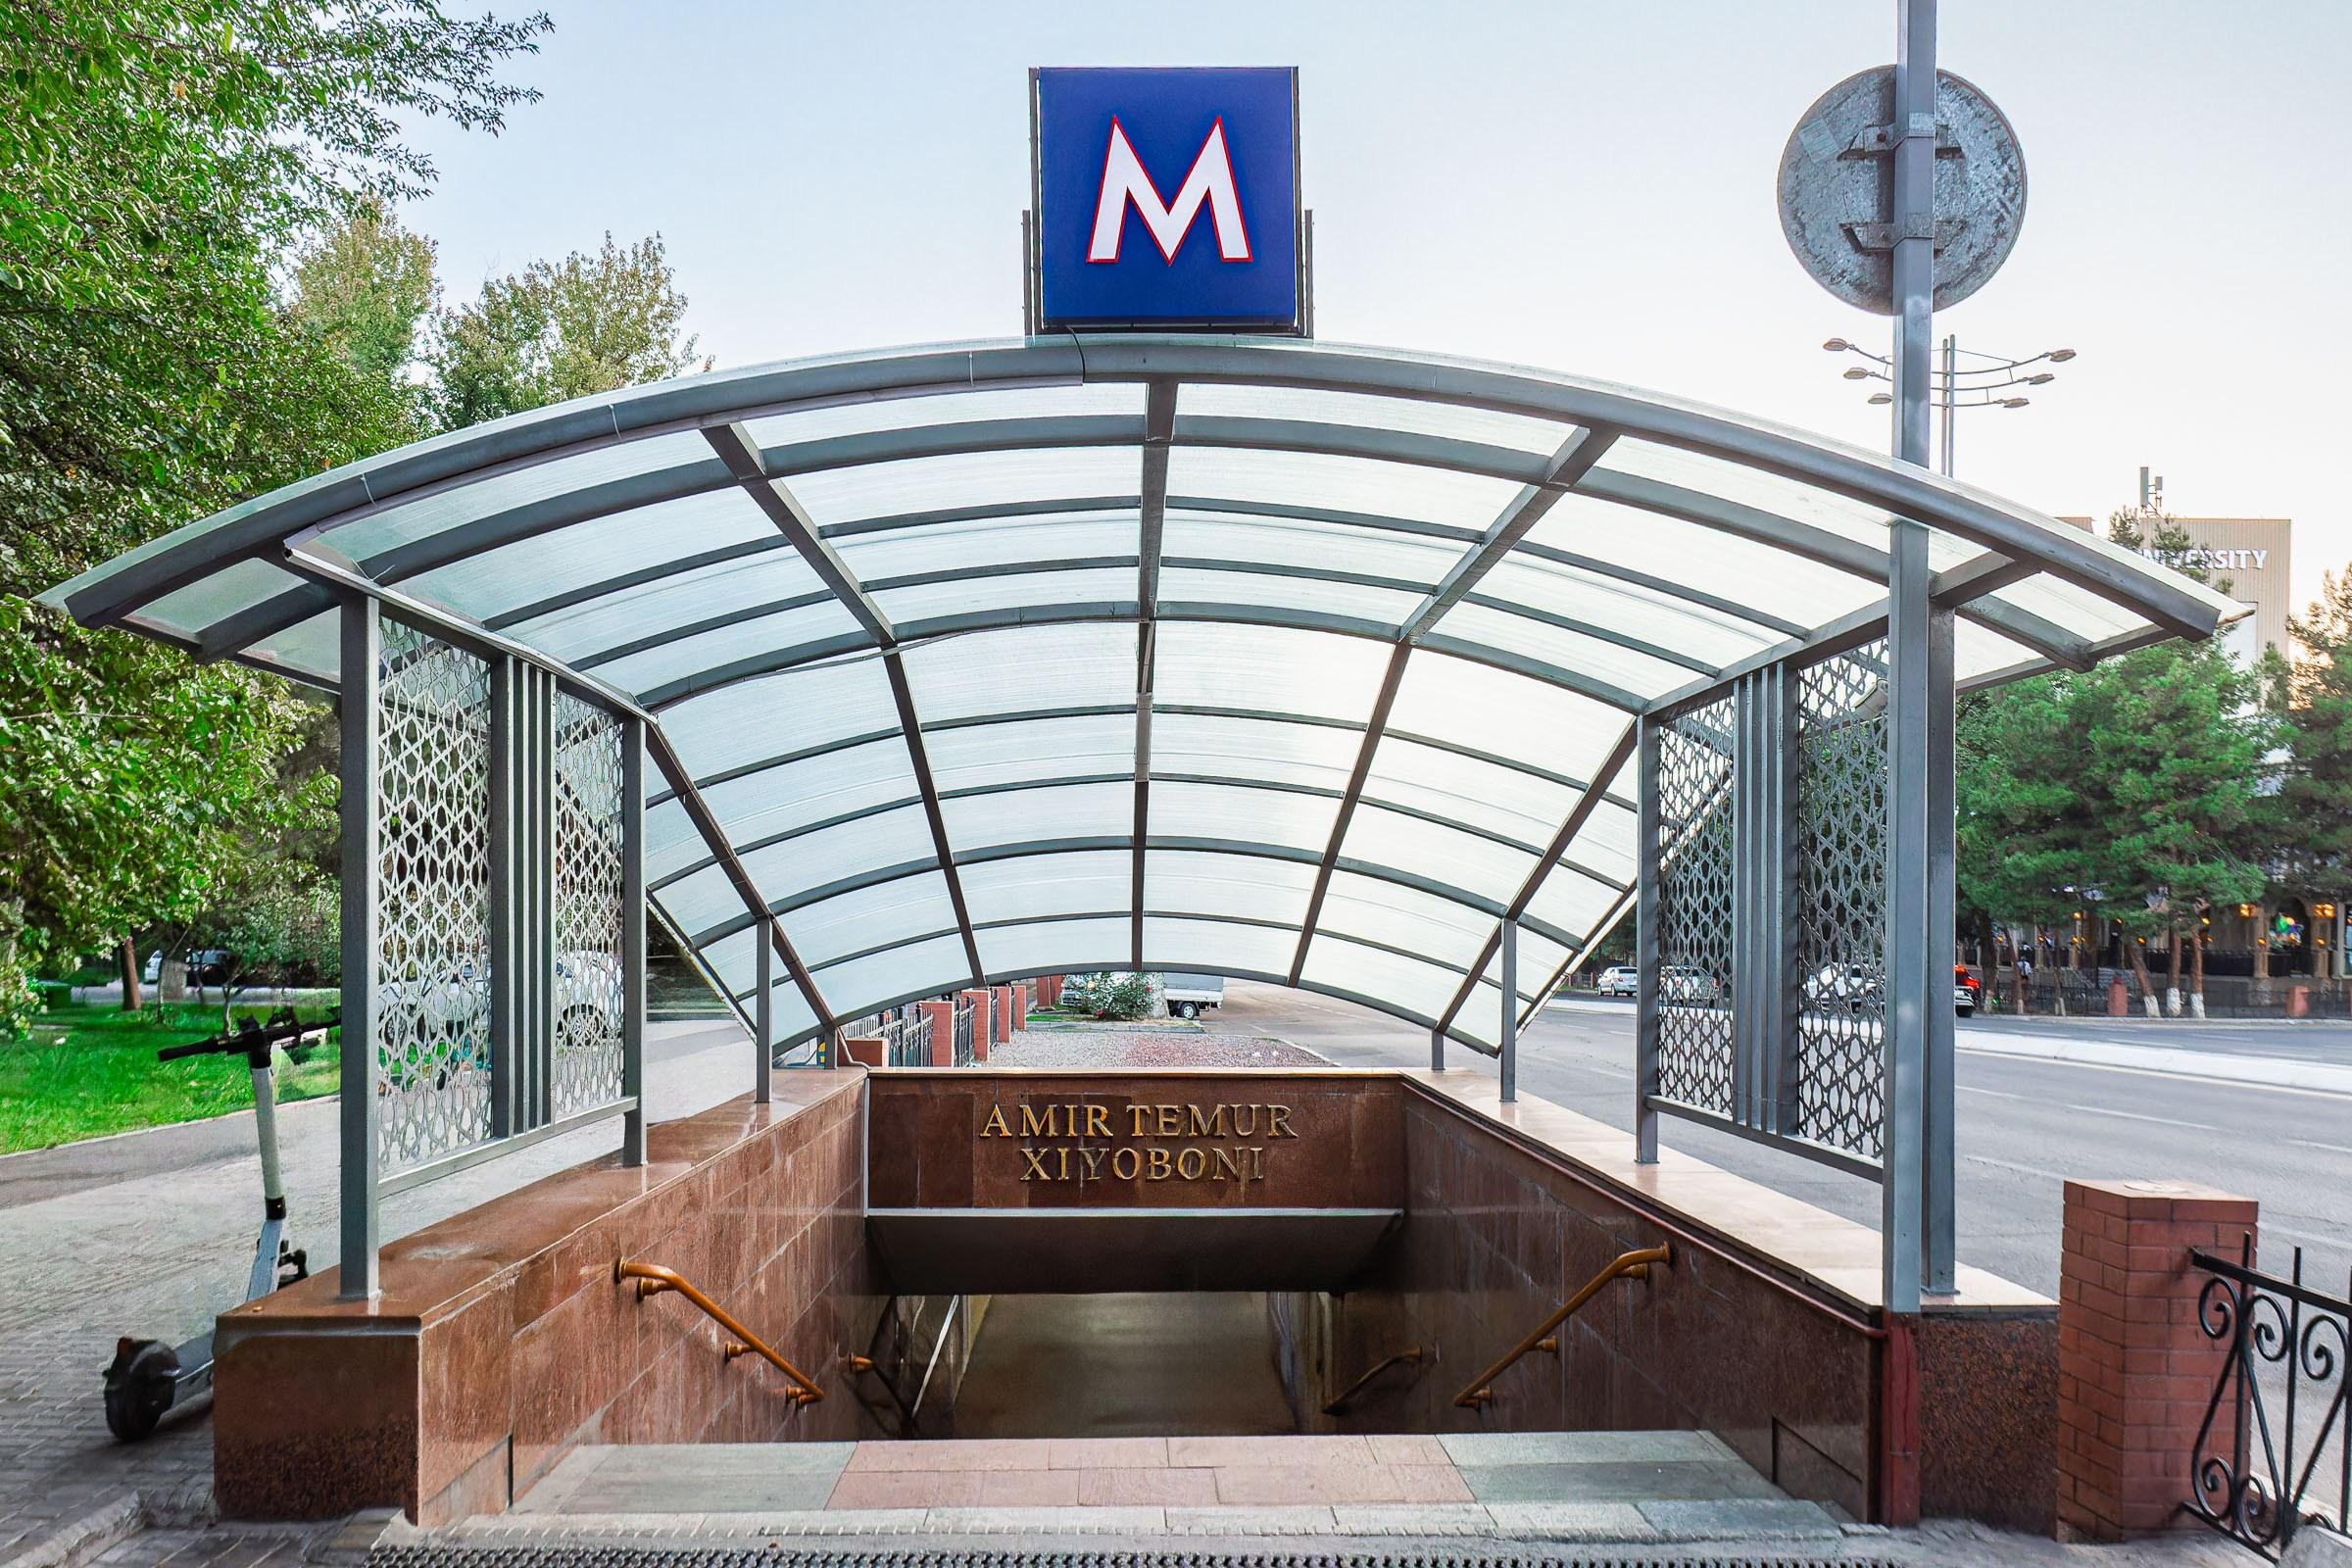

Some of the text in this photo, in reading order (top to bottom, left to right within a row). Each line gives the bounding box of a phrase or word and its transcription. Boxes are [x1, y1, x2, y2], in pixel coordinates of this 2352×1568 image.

[1086, 114, 1252, 267] M
[2137, 548, 2268, 570] NIVERSITY
[980, 1103, 1298, 1140] AMIR TEMUR
[1019, 1147, 1264, 1181] XIYOBONI
